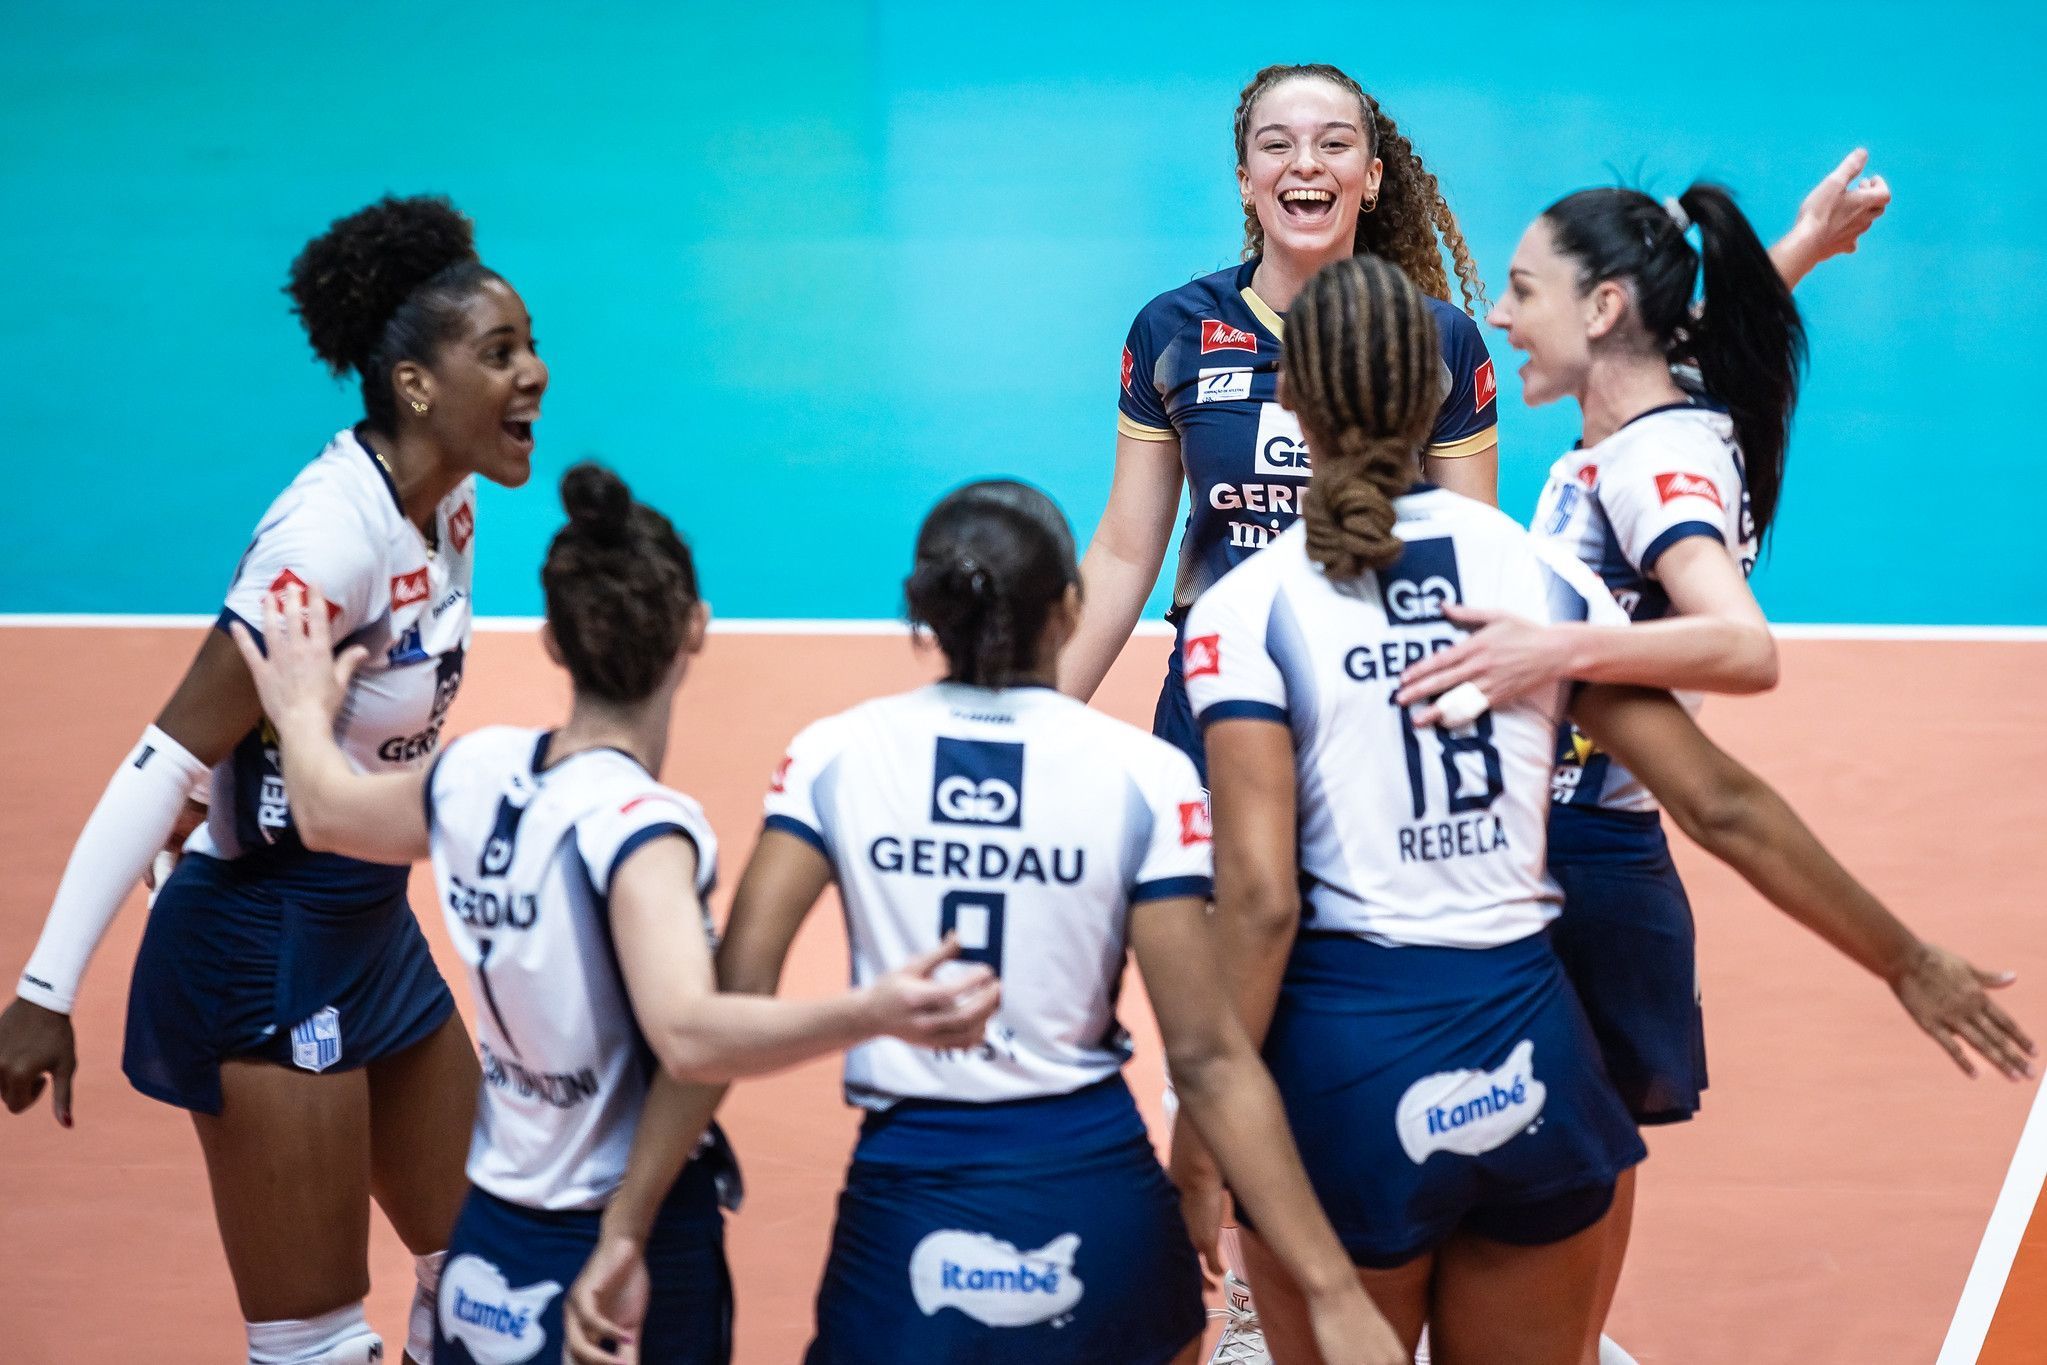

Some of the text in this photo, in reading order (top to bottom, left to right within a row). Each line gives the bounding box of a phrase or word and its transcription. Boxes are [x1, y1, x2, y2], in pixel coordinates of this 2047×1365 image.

[1208, 323, 1248, 345] Melitta
[1209, 483, 1310, 515] GER
[1389, 689, 1504, 819] 18
[870, 836, 1084, 885] GERDAU
[1400, 816, 1510, 862] REBECA
[1426, 1073, 1526, 1135] itambé
[941, 1258, 1061, 1295] itambé
